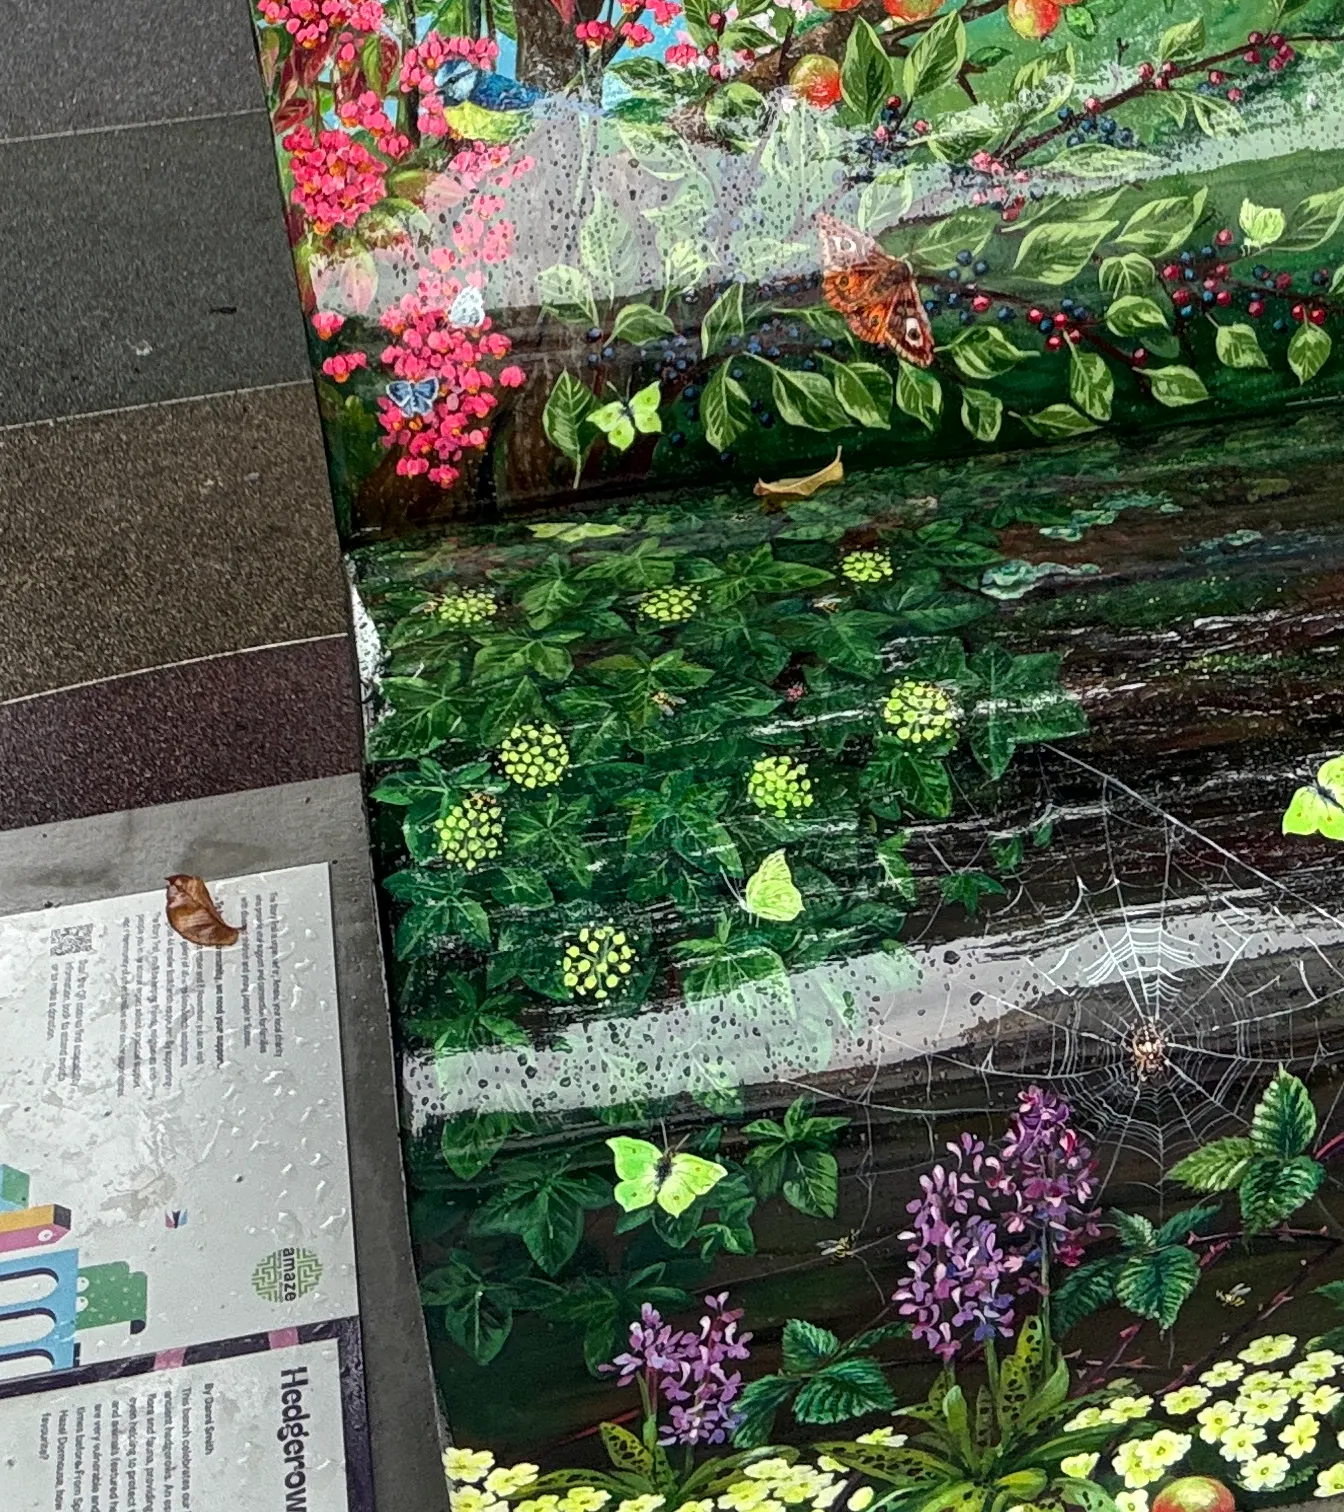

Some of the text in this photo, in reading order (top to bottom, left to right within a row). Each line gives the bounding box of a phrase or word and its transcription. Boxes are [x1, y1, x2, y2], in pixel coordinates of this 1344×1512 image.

[216, 996, 226, 1014] need
[214, 1016, 224, 1034] your
[283, 1248, 297, 1301] amaze
[59, 1410, 68, 1435] Hazel
[76, 1407, 86, 1433] times
[93, 1404, 102, 1419] are
[112, 1400, 122, 1418] and
[164, 1391, 173, 1425] ancient
[202, 1383, 214, 1456] By Danni Smith
[39, 1413, 52, 1460] favourite?
[90, 1420, 101, 1441] very
[111, 1420, 120, 1456] animals
[146, 1418, 156, 1435] and
[55, 1437, 68, 1489] Dormouse,
[126, 1397, 138, 1508] even helping to protect
[145, 1436, 156, 1466] fauna,
[162, 1427, 176, 1482] hedgerows.
[182, 1387, 192, 1509] This bench celebrates our
[74, 1470, 85, 1496] From
[92, 1443, 102, 1494] vulnerable
[109, 1457, 120, 1500] featured
[142, 1468, 155, 1512] providing
[164, 1484, 174, 1498] An
